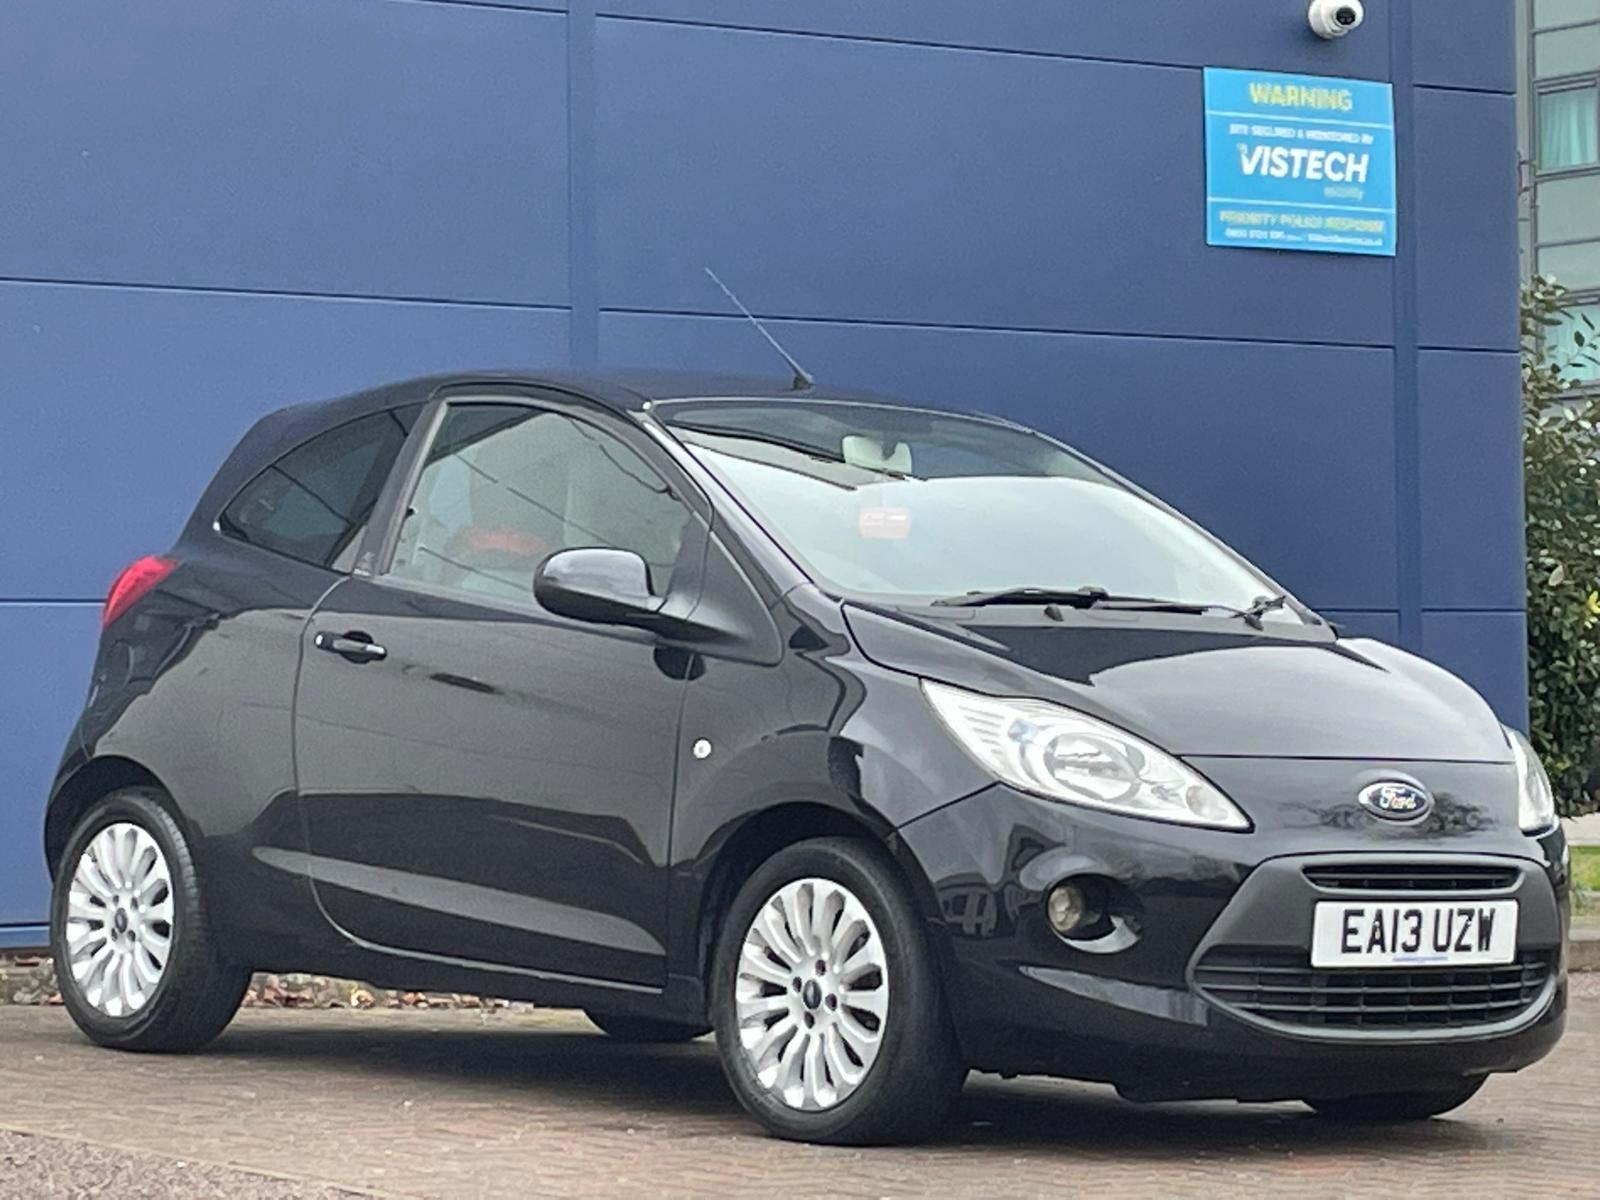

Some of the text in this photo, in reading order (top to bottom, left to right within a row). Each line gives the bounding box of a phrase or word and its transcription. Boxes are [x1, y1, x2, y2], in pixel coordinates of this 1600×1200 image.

[1249, 82, 1353, 111] WARNING
[1237, 143, 1369, 183] VISTECH
[1380, 785, 1417, 809] Ford
[1341, 908, 1496, 953] EA13 UZW
